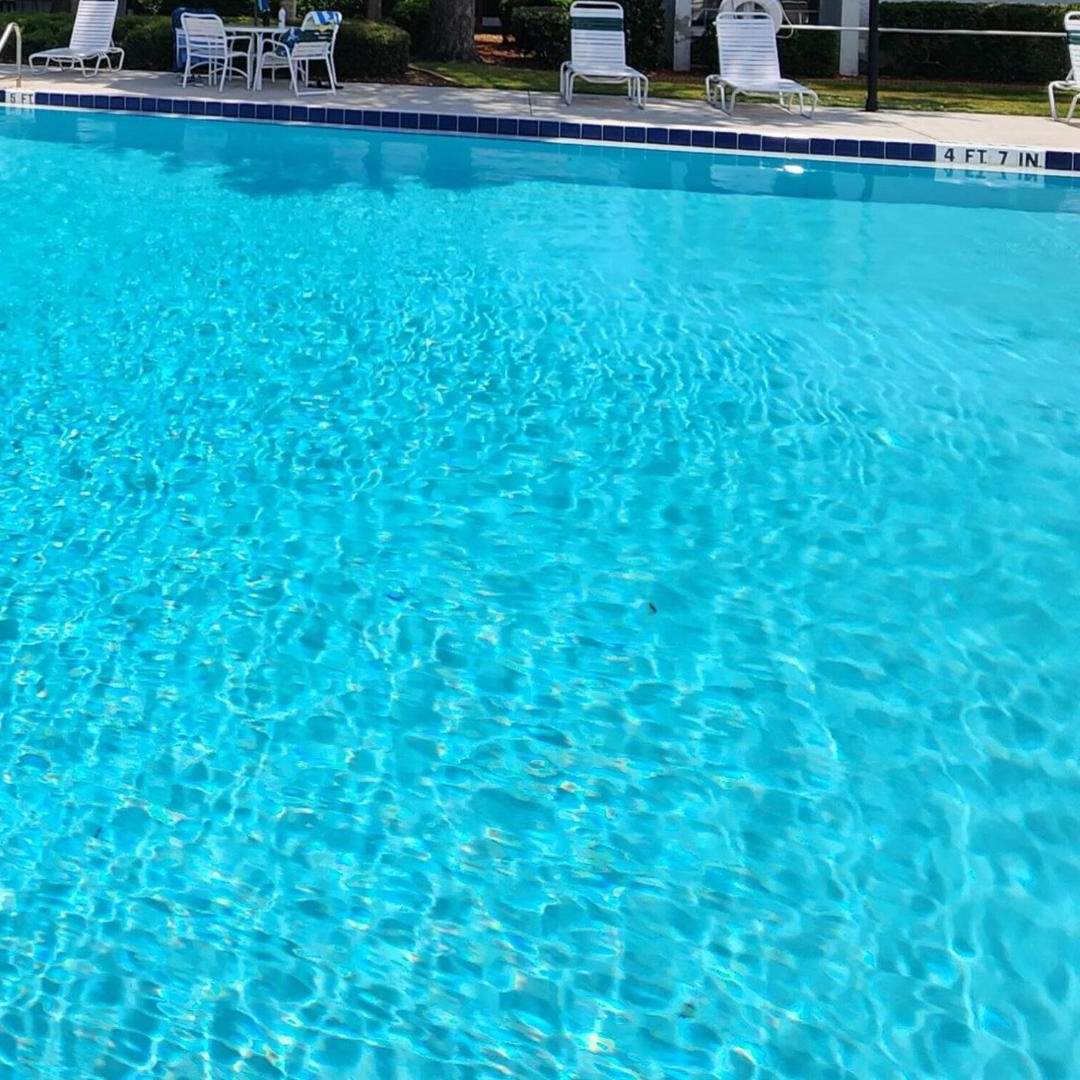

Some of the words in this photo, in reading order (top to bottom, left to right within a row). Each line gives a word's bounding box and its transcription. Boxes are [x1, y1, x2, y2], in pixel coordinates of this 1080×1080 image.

[10, 93, 16, 104] 5
[944, 148, 955, 162] 4
[998, 151, 1008, 165] 7
